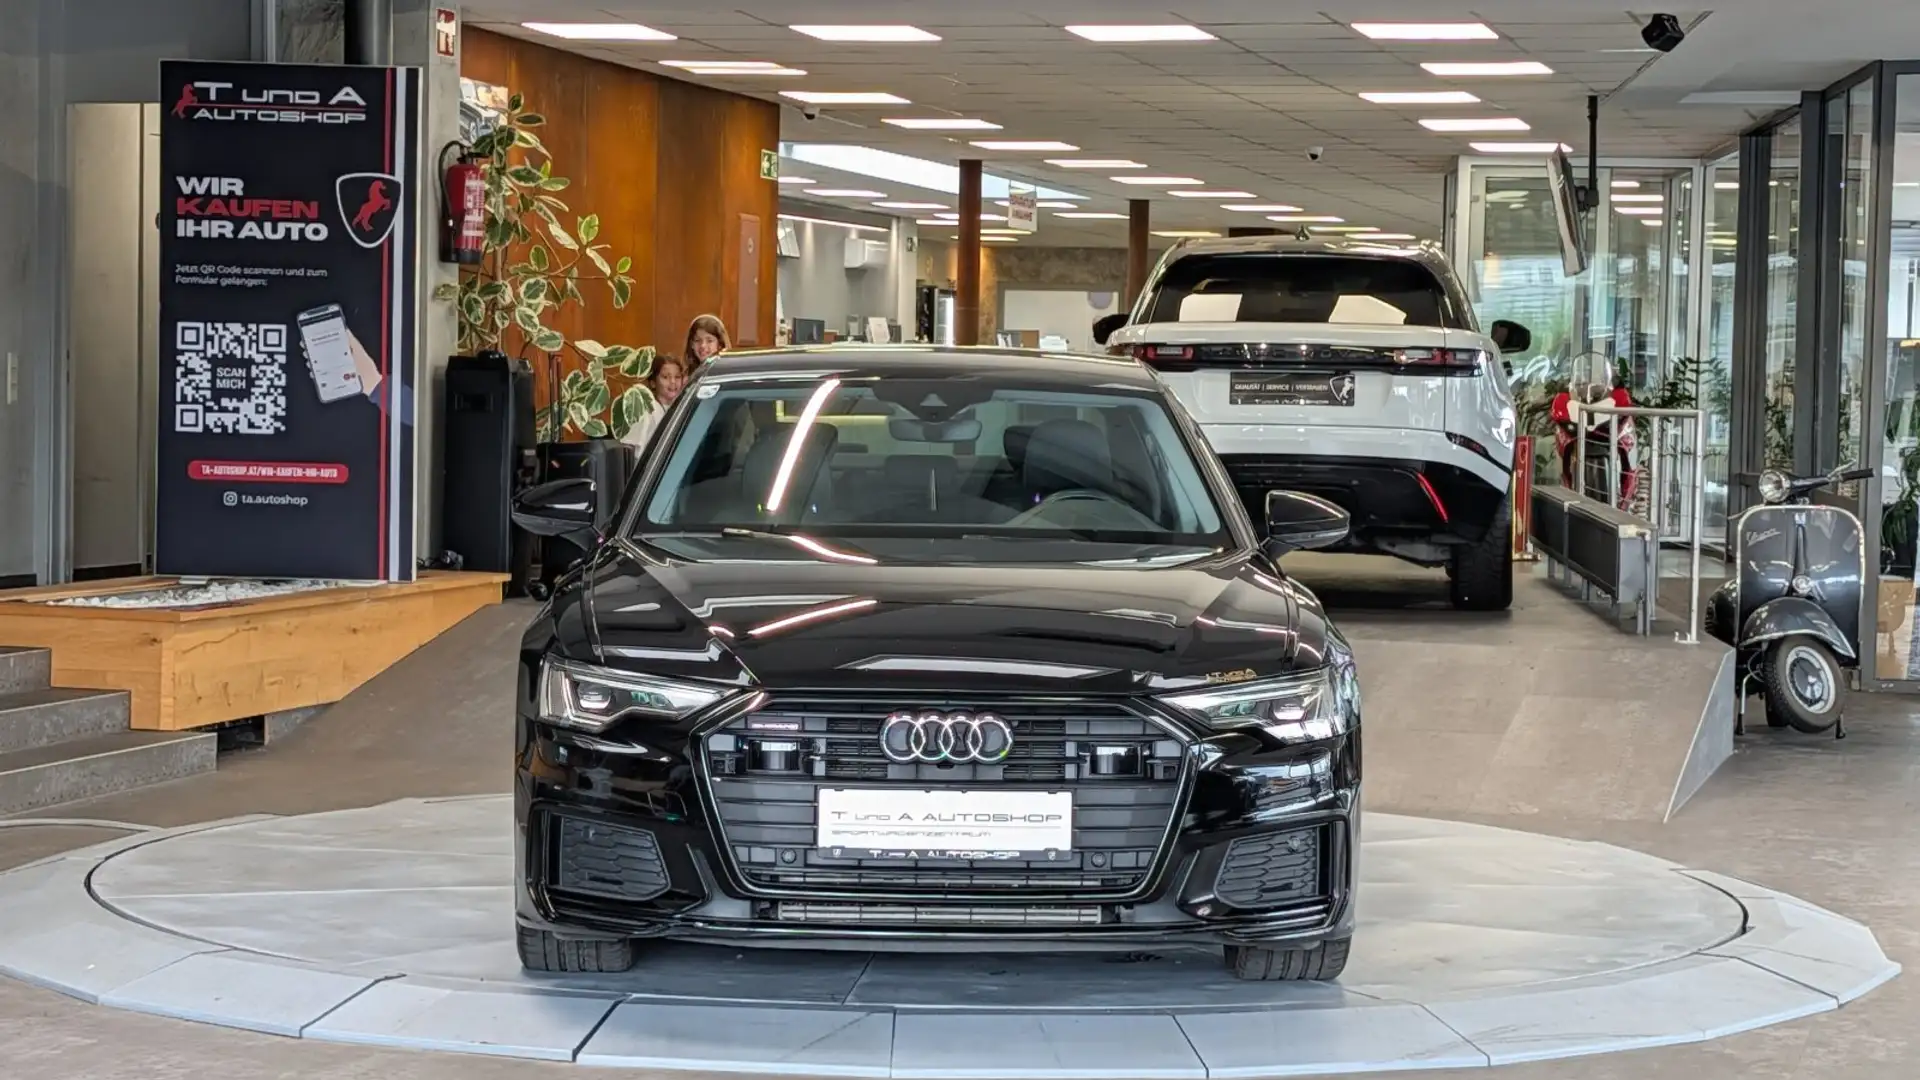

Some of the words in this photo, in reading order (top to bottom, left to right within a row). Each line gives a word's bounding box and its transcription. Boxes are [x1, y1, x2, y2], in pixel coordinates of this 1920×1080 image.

[194, 81, 233, 101] T
[328, 86, 367, 106] A
[193, 108, 366, 124] AUTOSHOP
[176, 176, 244, 196] WIR
[177, 197, 319, 218] KAUFEN
[177, 219, 234, 239] IHR
[237, 221, 329, 242] AUTO
[175, 264, 198, 274] Jetzt
[200, 264, 215, 275] QR
[217, 265, 242, 275] Code
[243, 266, 283, 276] scannen
[286, 267, 304, 277] und
[306, 268, 328, 277] zum
[175, 275, 219, 285] Formular
[216, 367, 246, 378] SCAN
[216, 378, 246, 389] MICH
[1266, 383, 1290, 391] SERVICE
[241, 494, 309, 507] ta.autoshop
[831, 811, 848, 820] T
[898, 812, 913, 821] A
[922, 812, 1063, 823] AUTOSHOP
[869, 849, 882, 859] T
[907, 850, 919, 859] A
